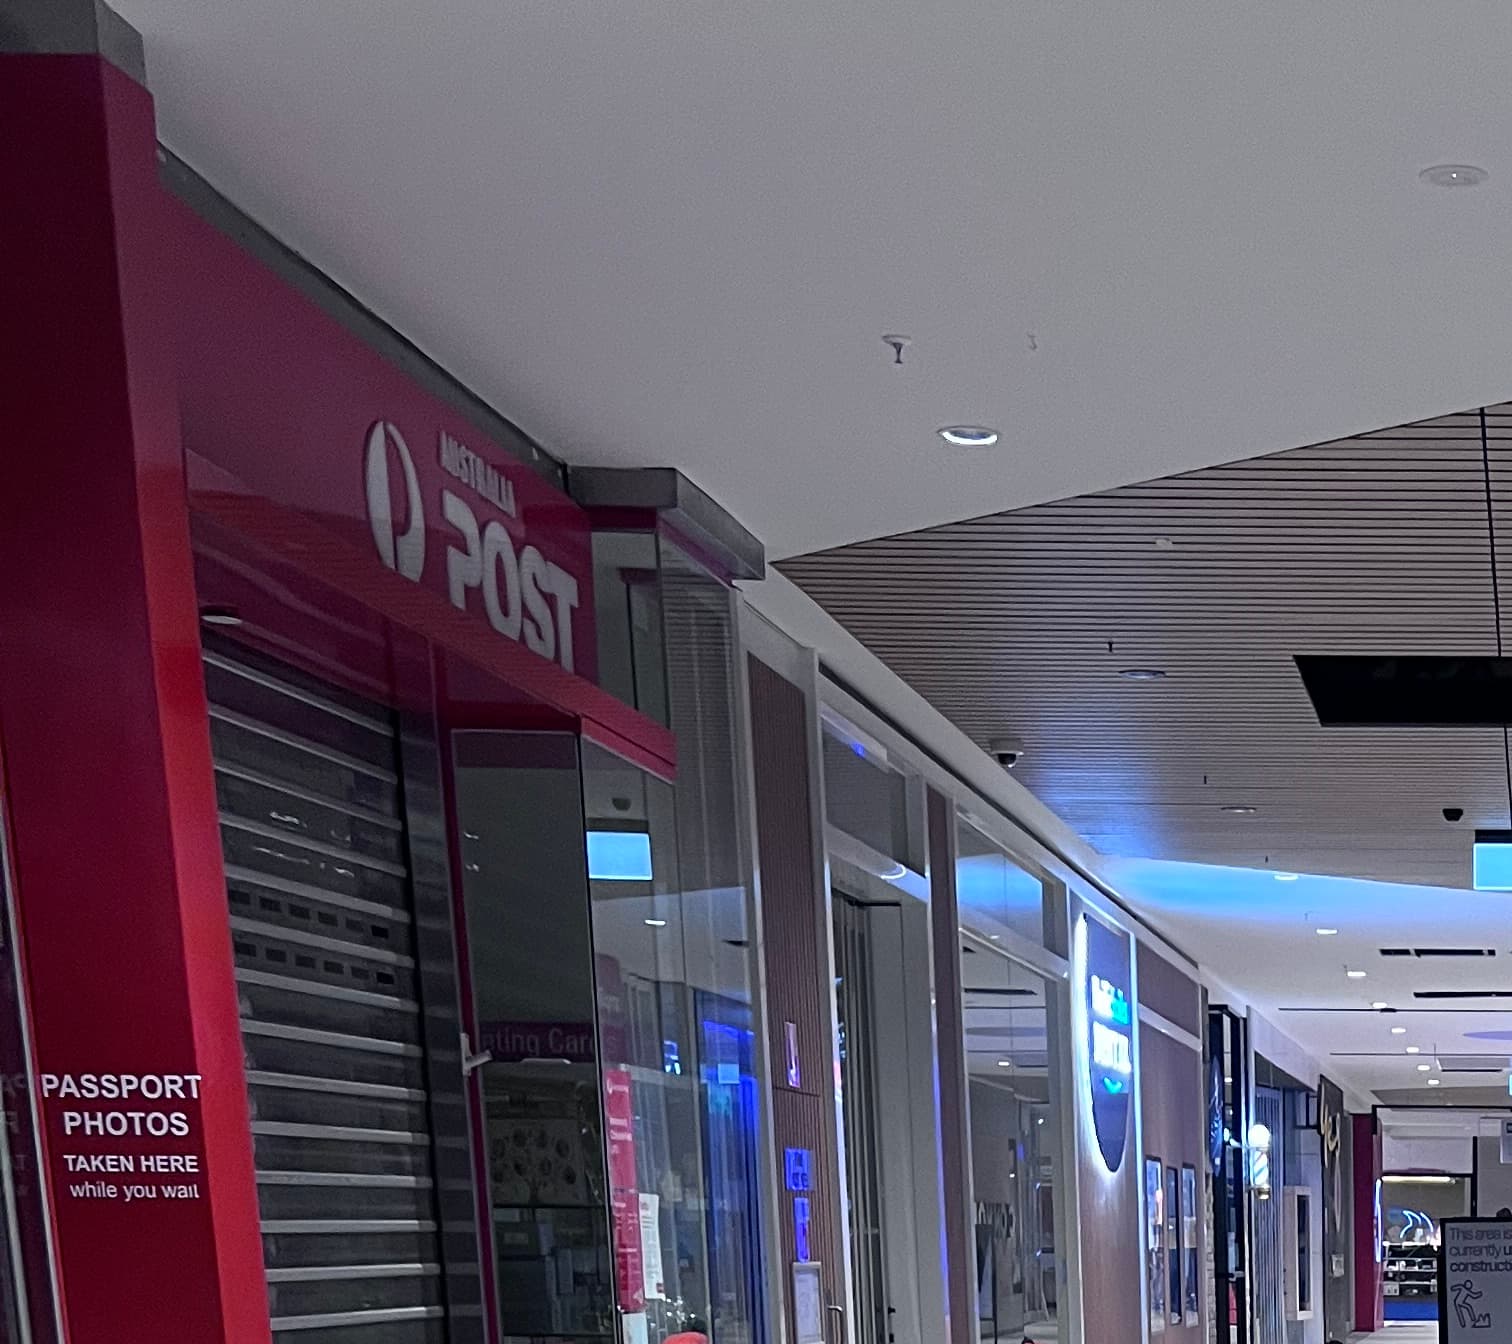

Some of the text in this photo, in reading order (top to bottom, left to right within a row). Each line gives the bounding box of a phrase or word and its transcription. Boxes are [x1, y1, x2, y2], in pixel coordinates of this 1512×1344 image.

[442, 489, 579, 675] POST
[41, 1074, 202, 1099] PASSPORT
[63, 1111, 189, 1136] PHOTOS
[63, 1154, 200, 1173] TAKEN HERE
[69, 1181, 200, 1202] while you wait
[1451, 1228, 1512, 1241] This area is
[1449, 1245, 1501, 1260] currently
